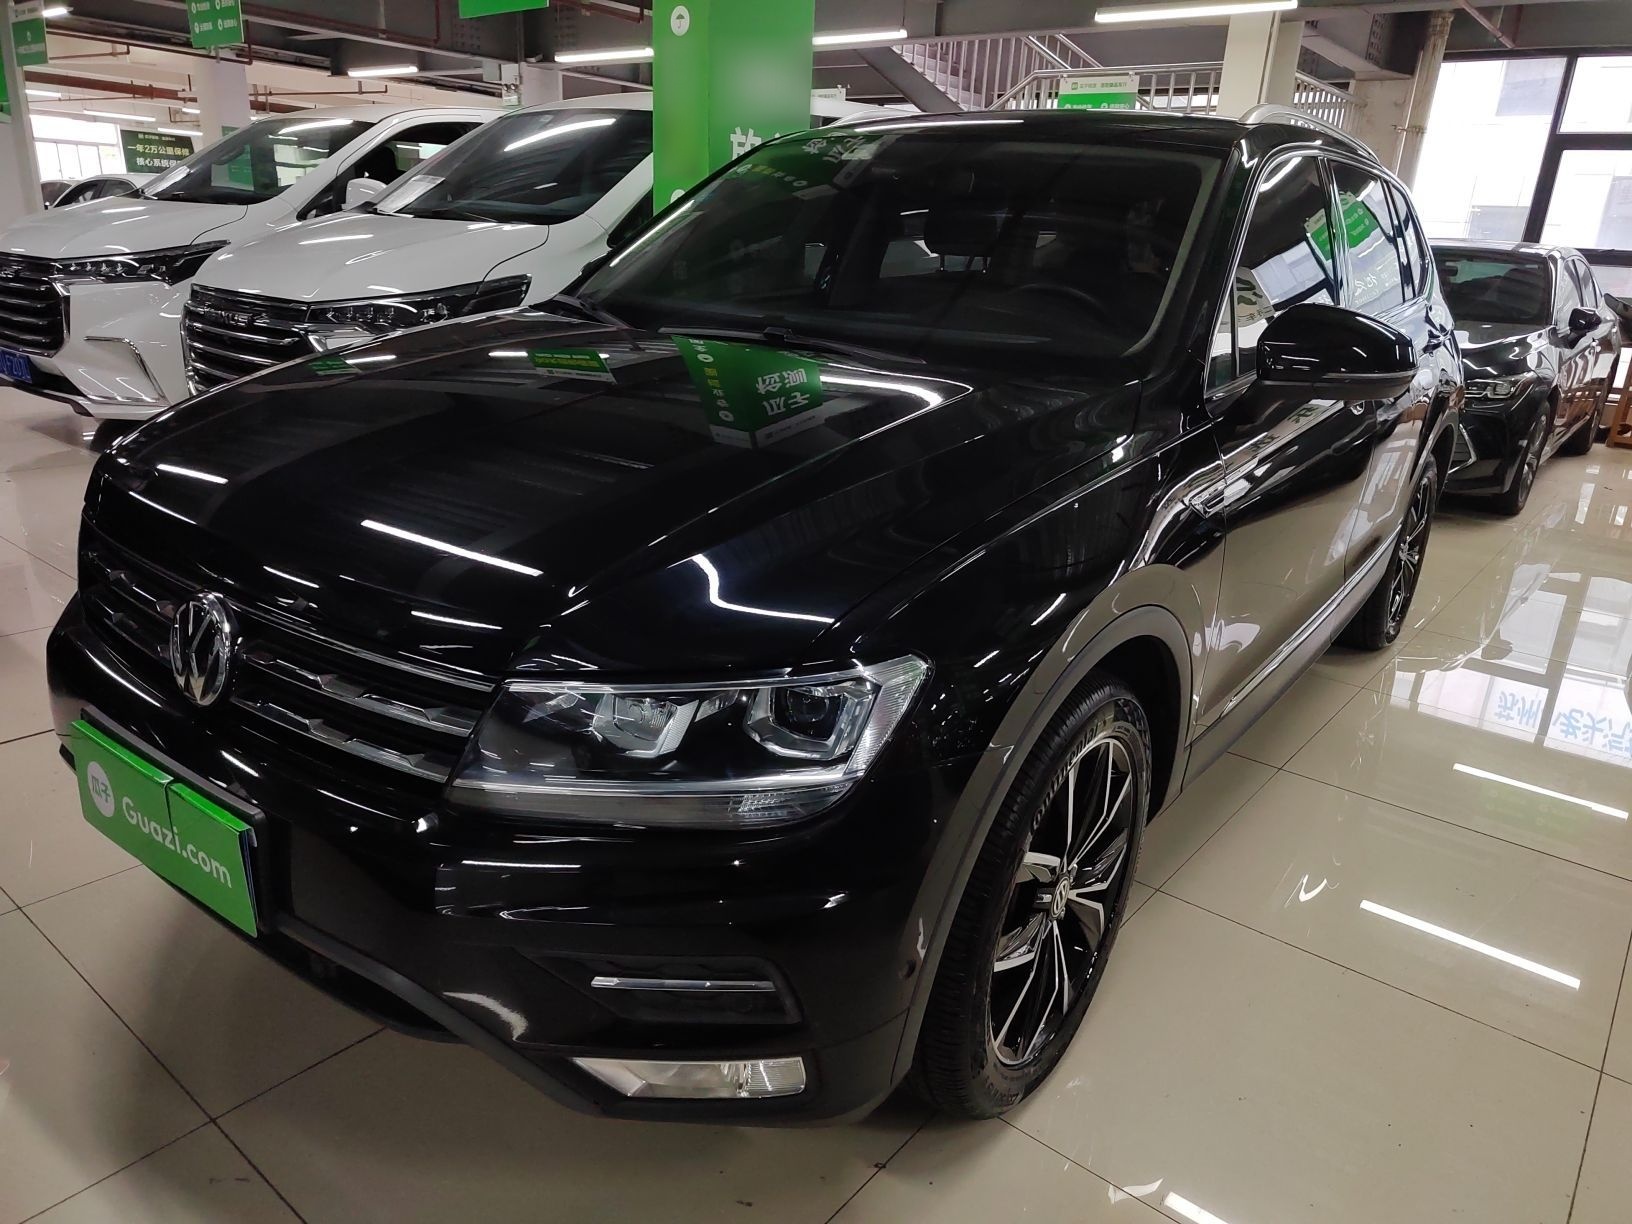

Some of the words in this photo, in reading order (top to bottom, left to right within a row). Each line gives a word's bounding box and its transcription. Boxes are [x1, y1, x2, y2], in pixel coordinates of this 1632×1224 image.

[136, 157, 181, 168] 核心系统保
[122, 796, 233, 889] Guazi.com
